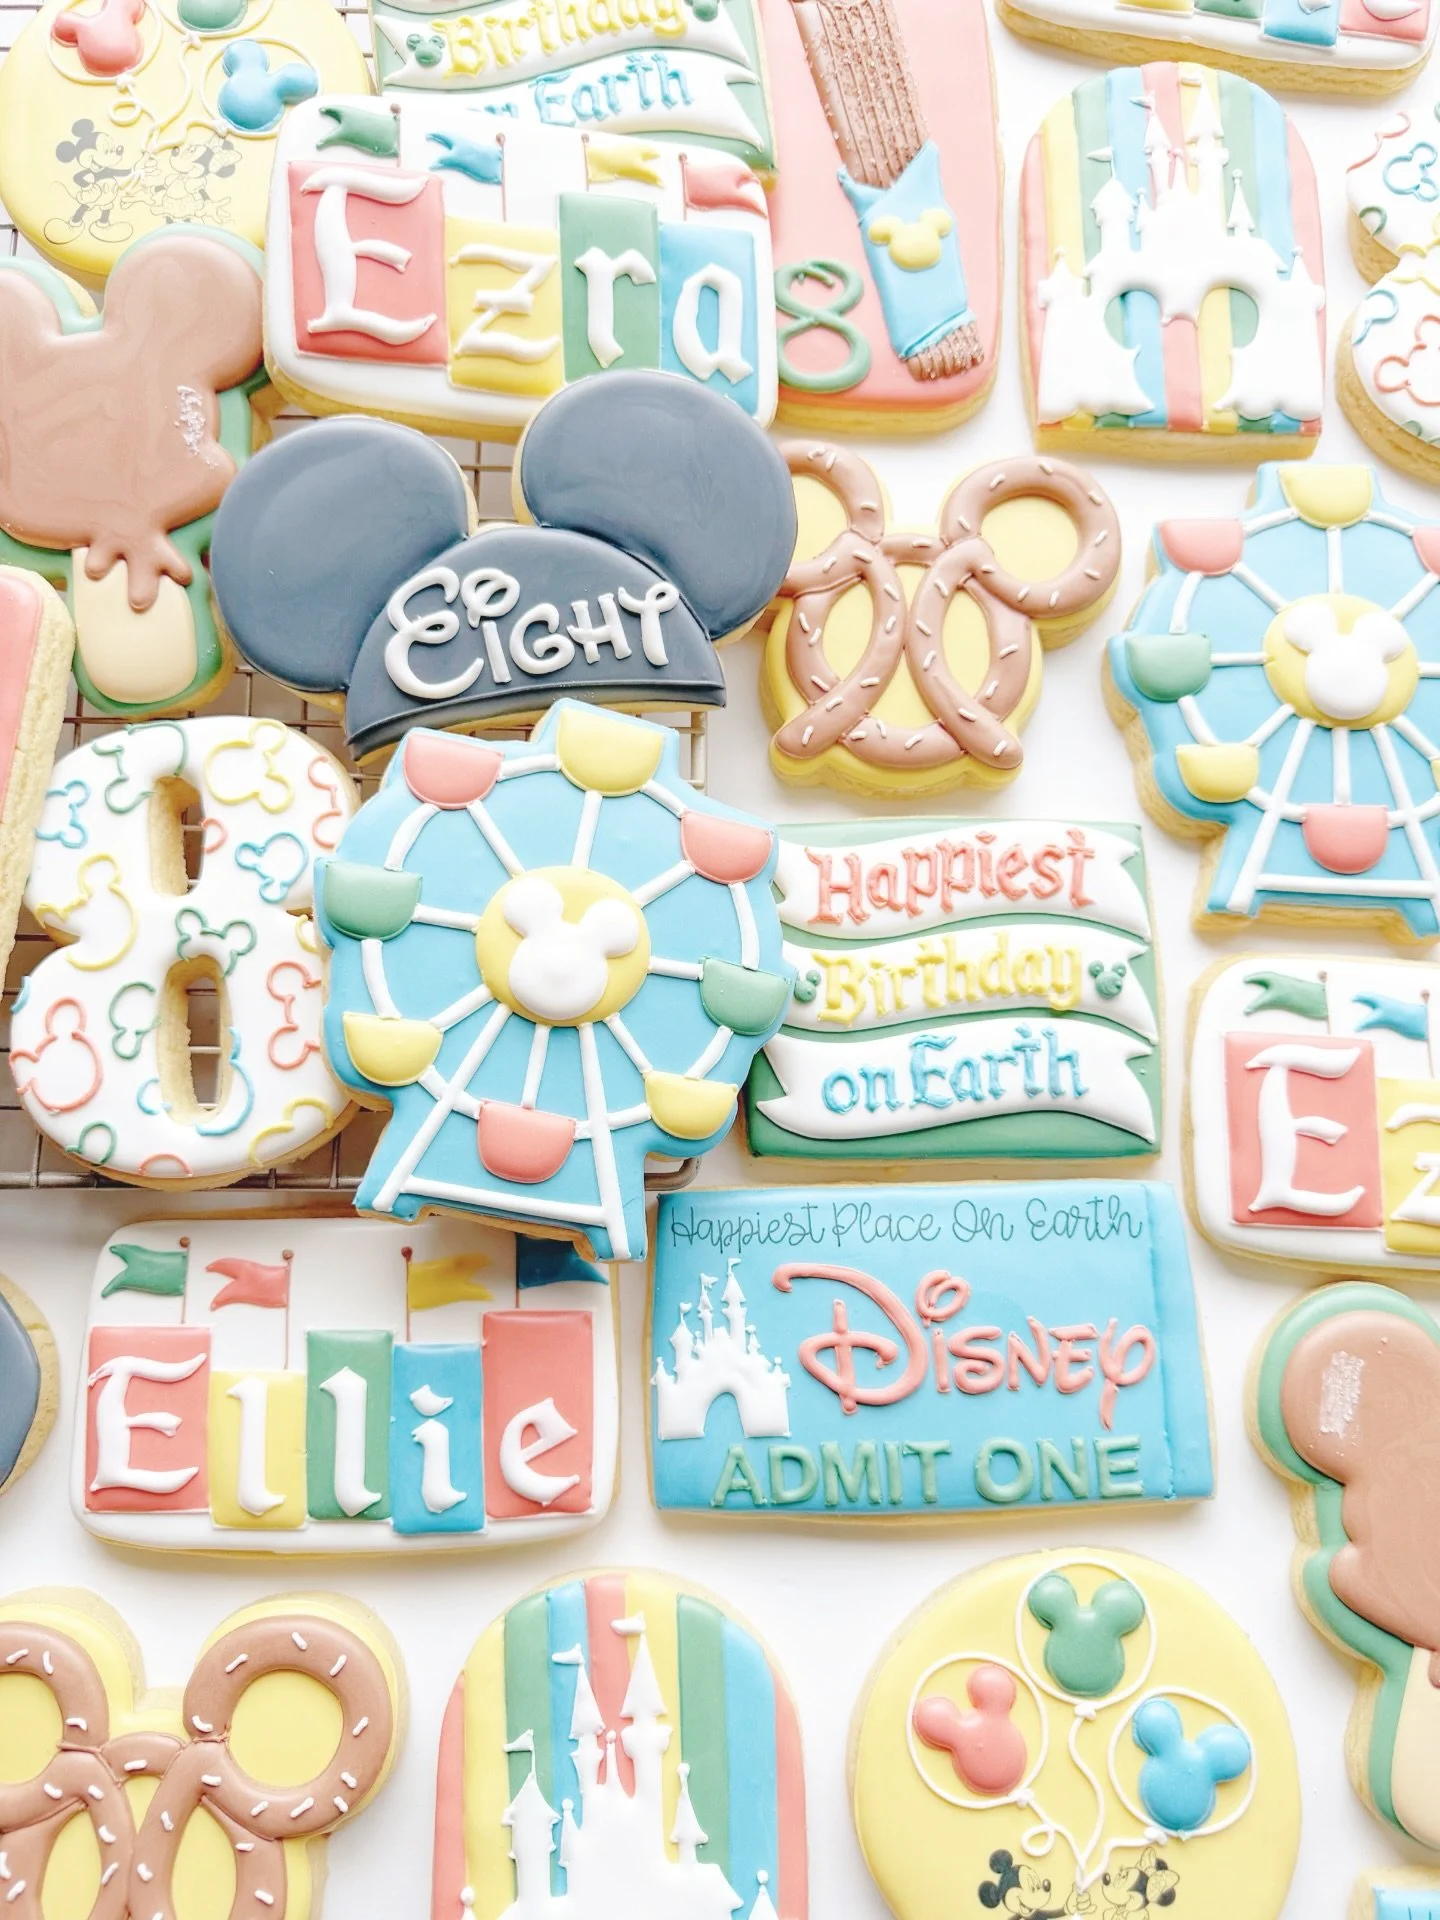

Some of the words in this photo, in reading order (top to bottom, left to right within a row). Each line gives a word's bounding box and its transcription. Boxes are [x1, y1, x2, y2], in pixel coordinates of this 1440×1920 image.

[528, 53, 693, 127] Earth
[300, 167, 754, 384] Ezra
[804, 828, 1096, 926] Happiest
[812, 933, 1083, 1027] Birthday
[821, 1063, 903, 1114] on
[908, 1023, 1090, 1109] Earth
[670, 1204, 828, 1254] Happiest
[831, 1200, 942, 1247] Place
[951, 1200, 1015, 1243] On
[1026, 1194, 1144, 1241] Earth
[87, 1352, 582, 1517] Ellie
[710, 1439, 952, 1507] ADMIT
[974, 1435, 1146, 1503] ONE
